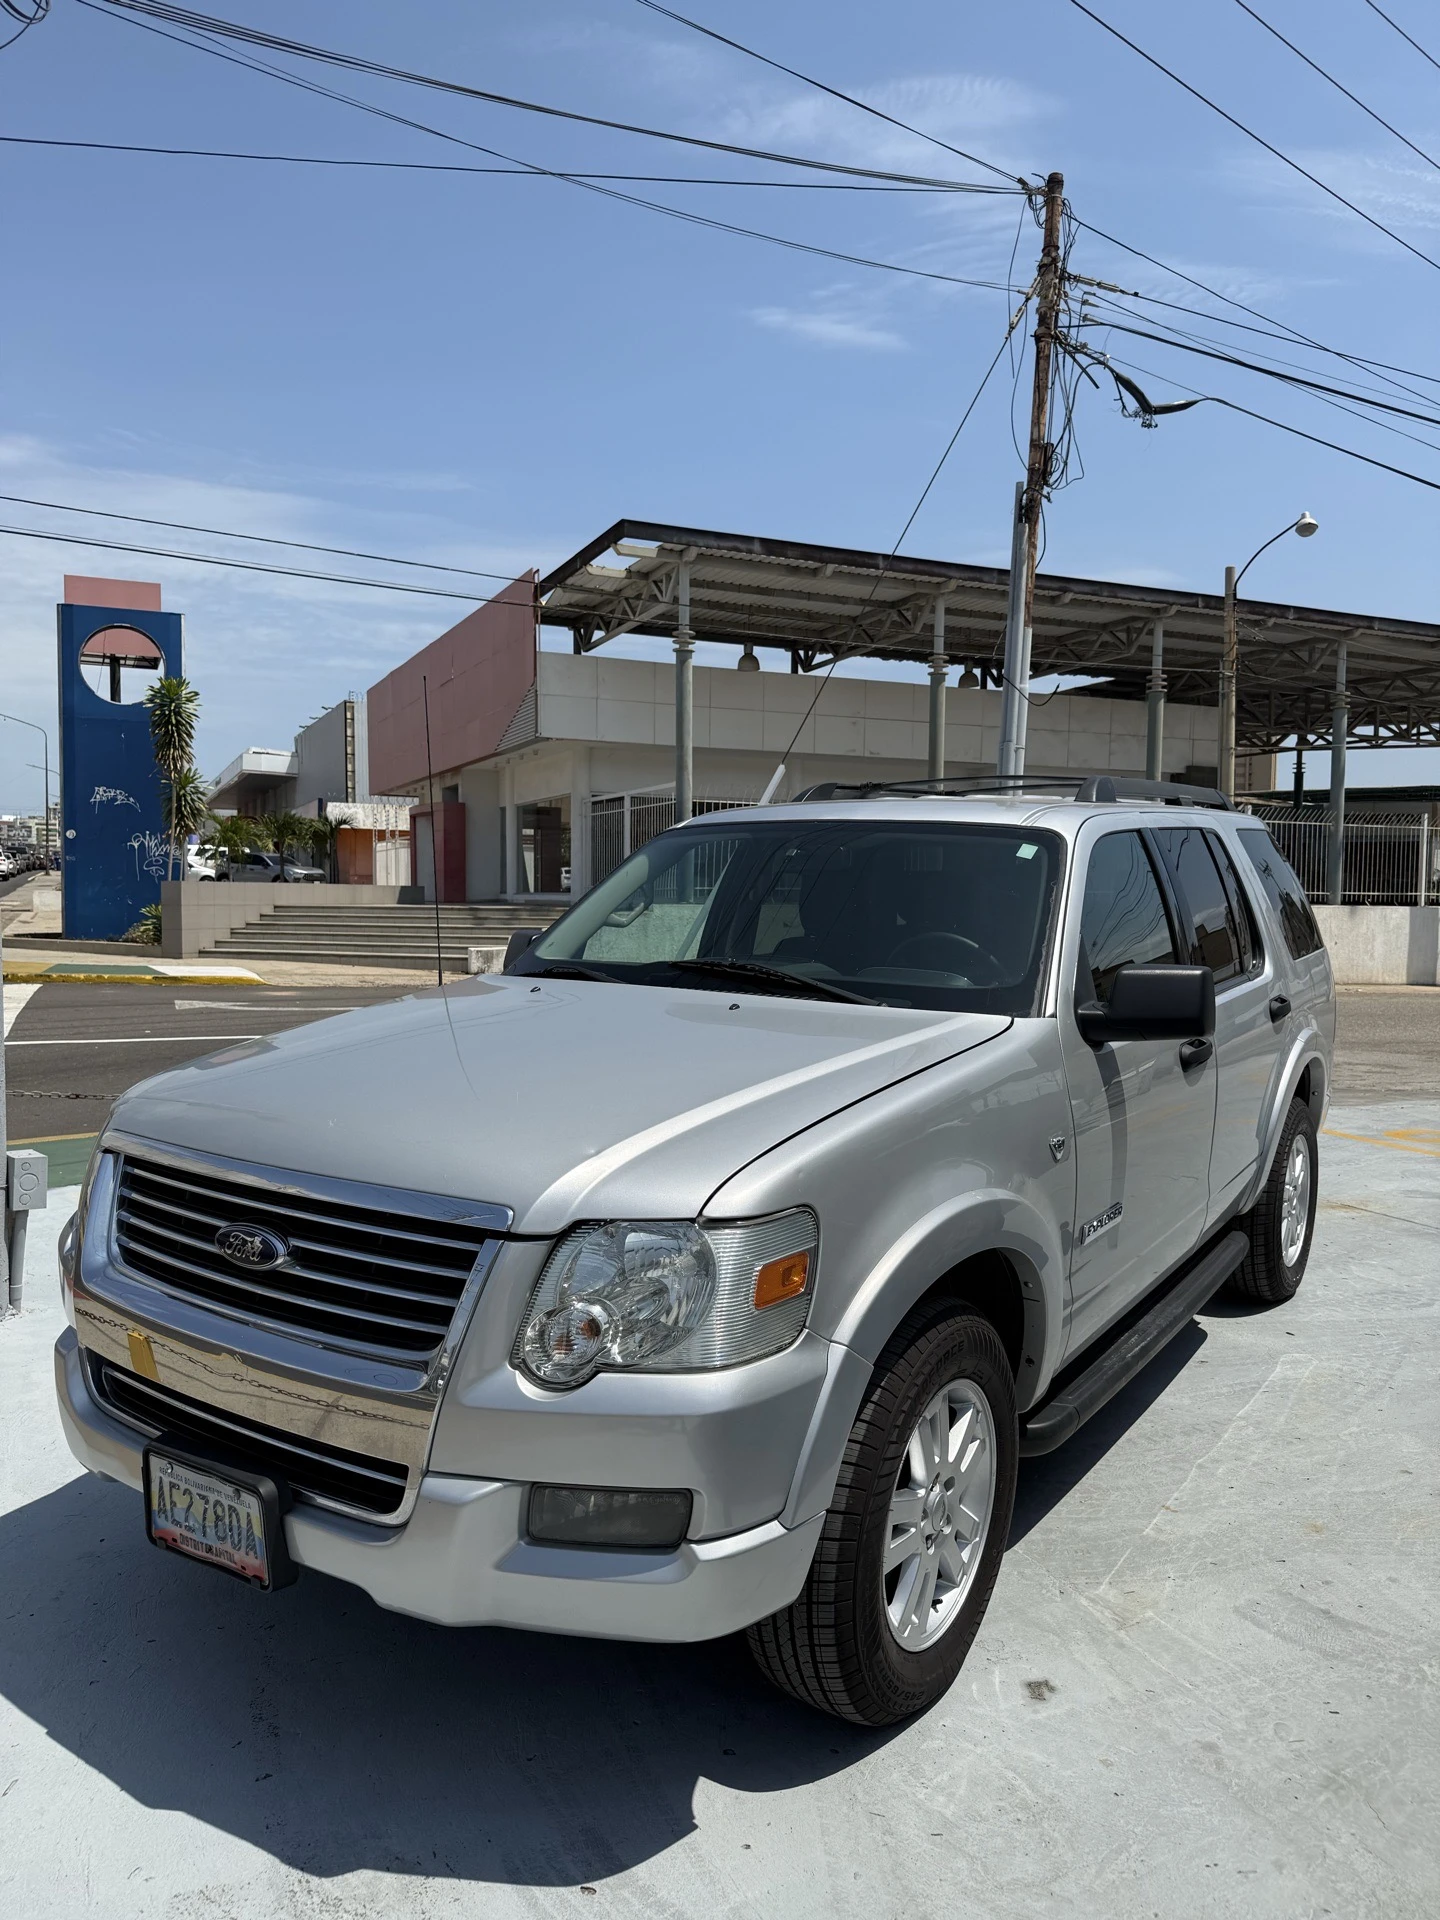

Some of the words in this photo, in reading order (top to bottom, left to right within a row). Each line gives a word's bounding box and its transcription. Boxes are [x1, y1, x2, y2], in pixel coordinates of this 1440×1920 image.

[1087, 1205, 1122, 1237] EXPLORER
[224, 1231, 263, 1261] Ford
[157, 1476, 258, 1560] AE278DA
